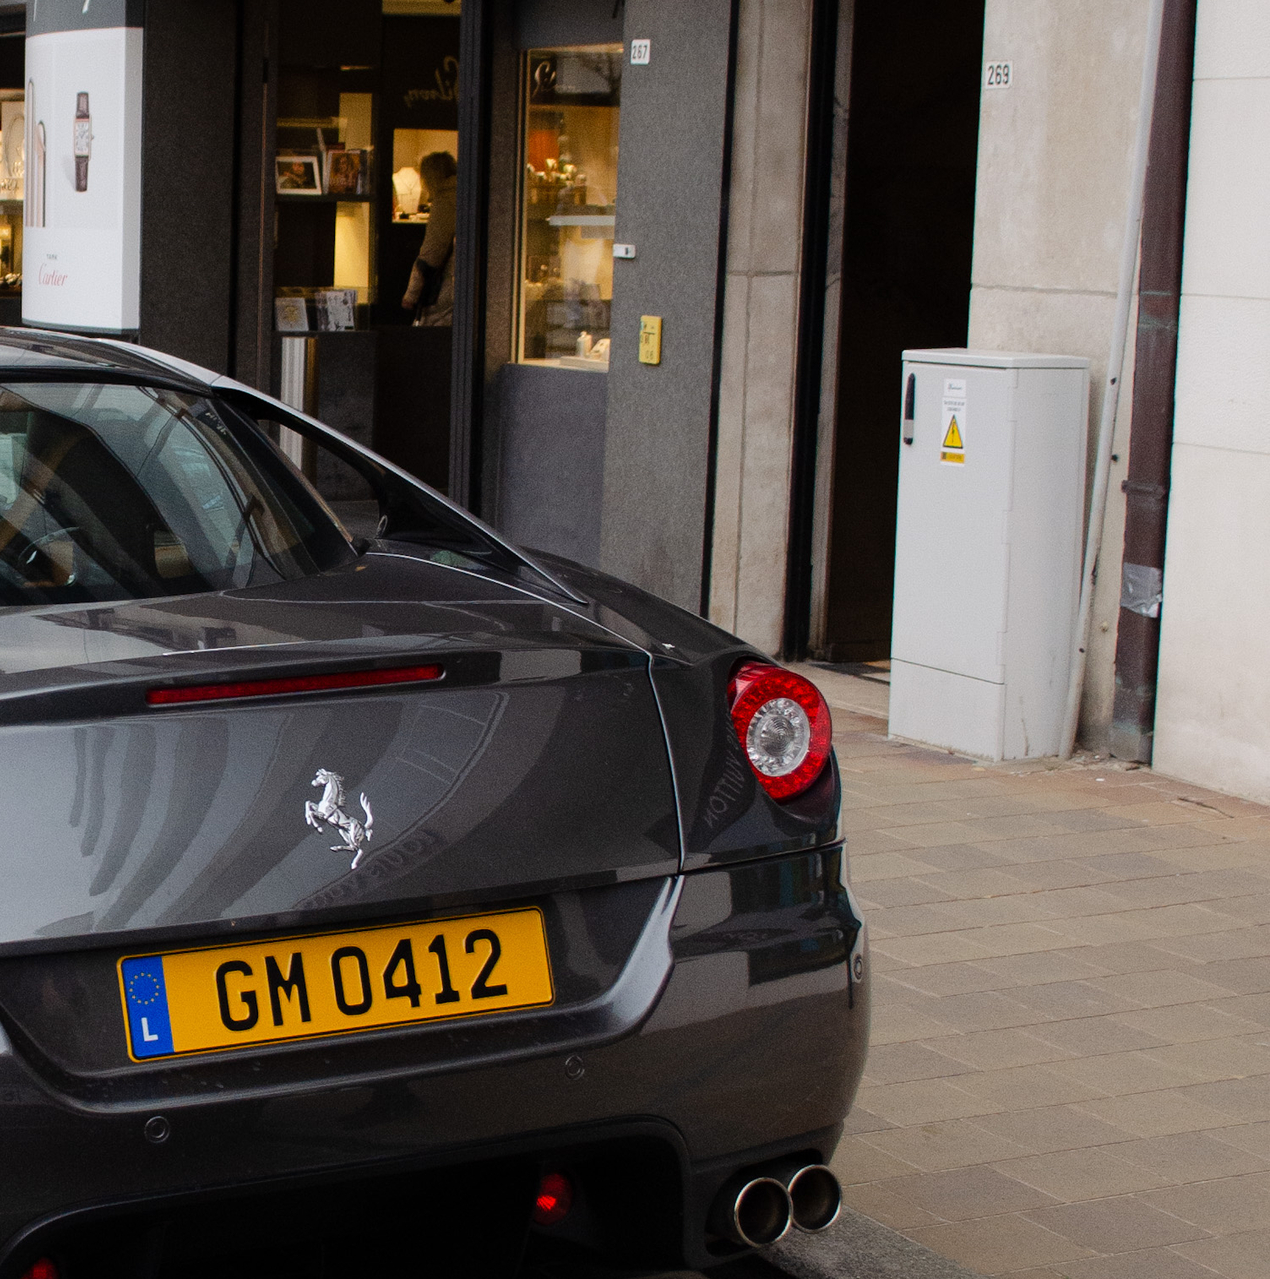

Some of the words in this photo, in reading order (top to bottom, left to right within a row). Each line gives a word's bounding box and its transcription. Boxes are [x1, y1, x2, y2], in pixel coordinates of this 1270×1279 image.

[632, 44, 648, 60] 267
[987, 64, 1010, 86] 269
[38, 263, 68, 286] Cartier
[215, 952, 312, 1032] GM
[330, 928, 508, 1016] 0412
[141, 1017, 159, 1042] L
